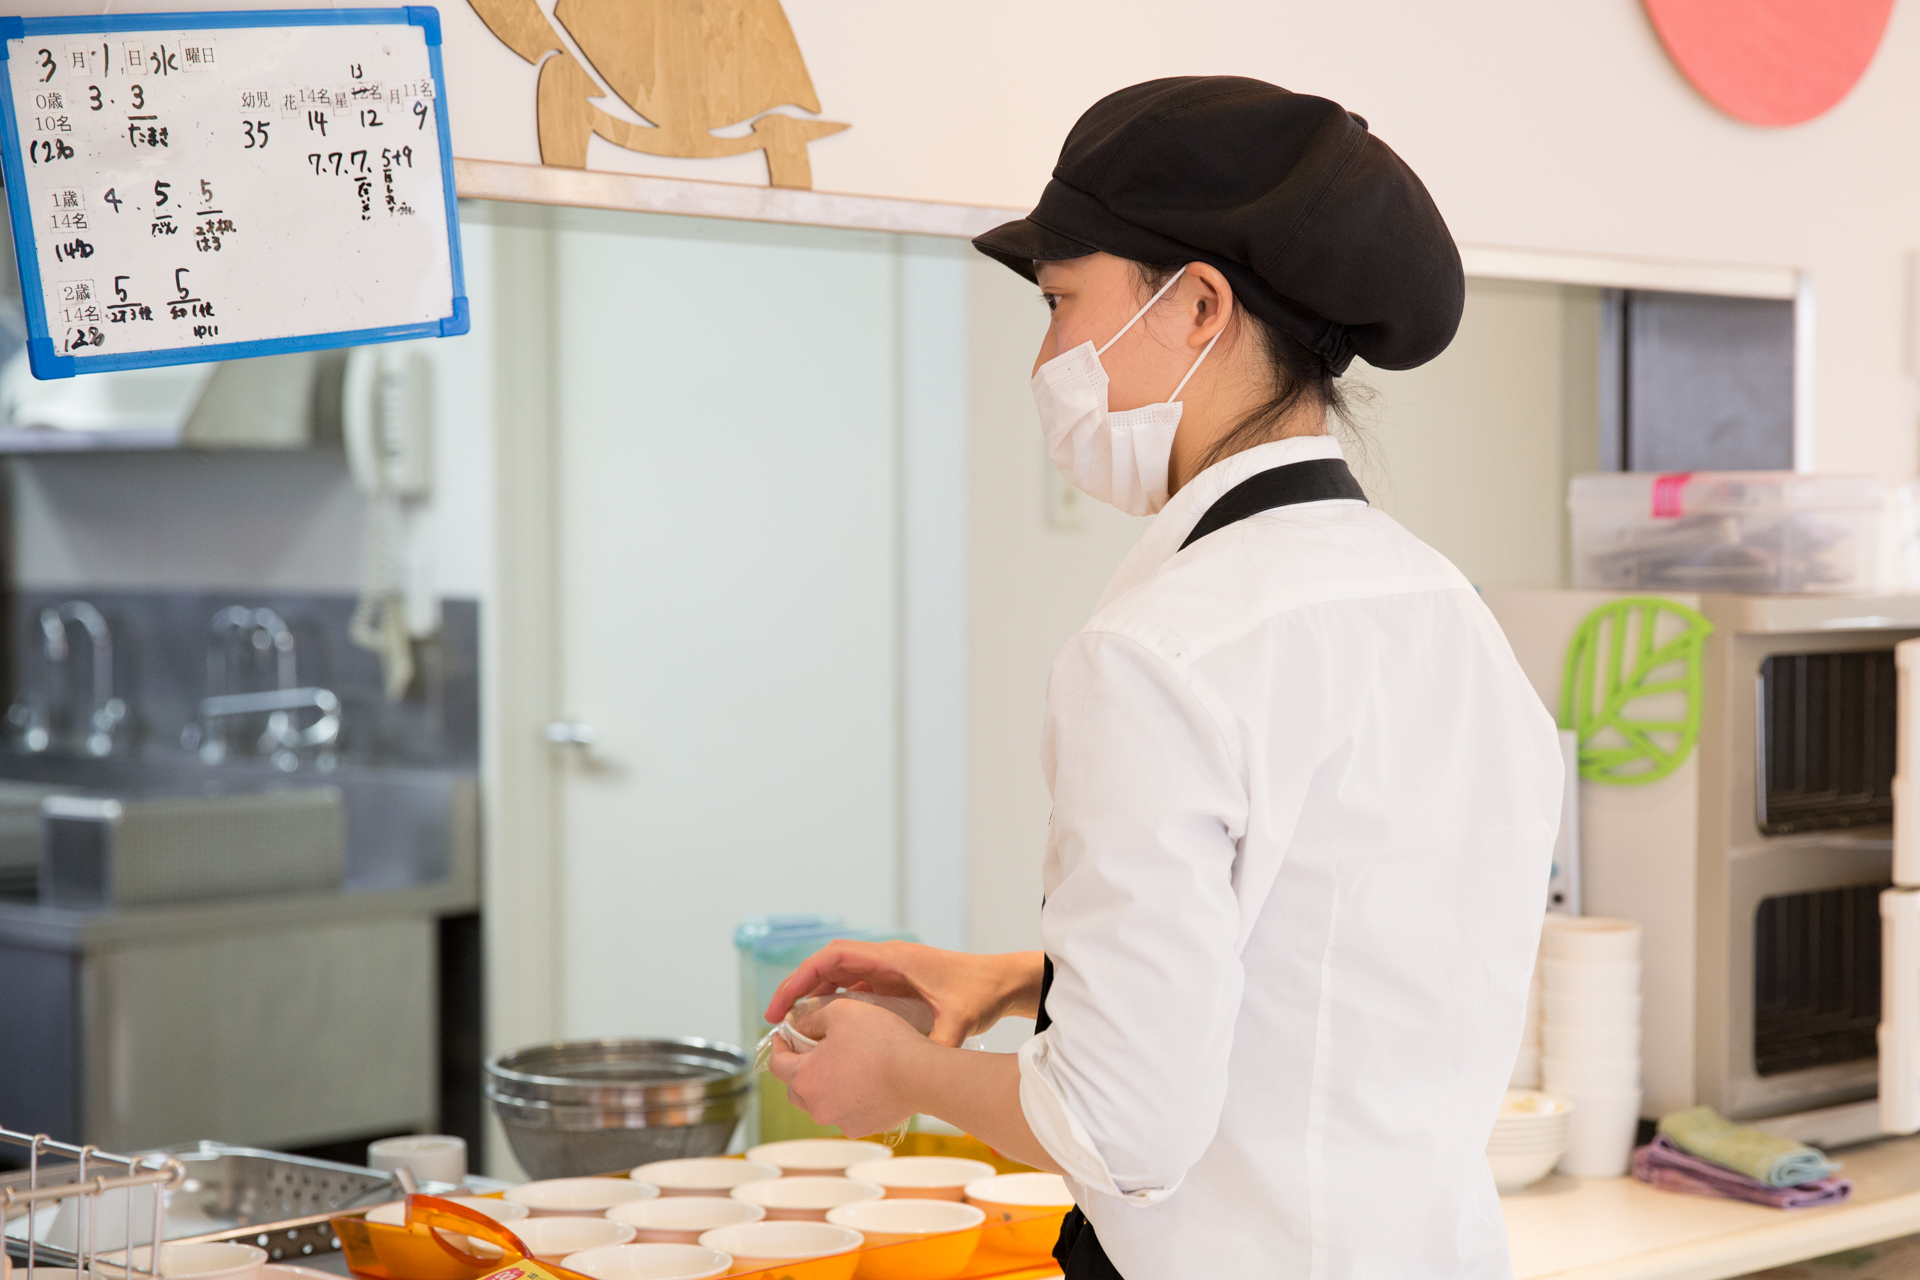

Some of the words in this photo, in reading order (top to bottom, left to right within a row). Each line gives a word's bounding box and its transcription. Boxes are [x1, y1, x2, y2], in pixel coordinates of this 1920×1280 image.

[241, 91, 271, 108] 幼児
[35, 114, 72, 132] 10名
[242, 120, 270, 149] 35
[308, 110, 328, 137] 14
[360, 109, 383, 128] 12
[413, 101, 428, 130] 9
[52, 190, 79, 208] 1歳
[50, 213, 88, 229] 14名
[63, 284, 91, 301] 2歳
[115, 275, 130, 302] 5
[175, 267, 190, 300] 5
[63, 306, 100, 323] 14名
